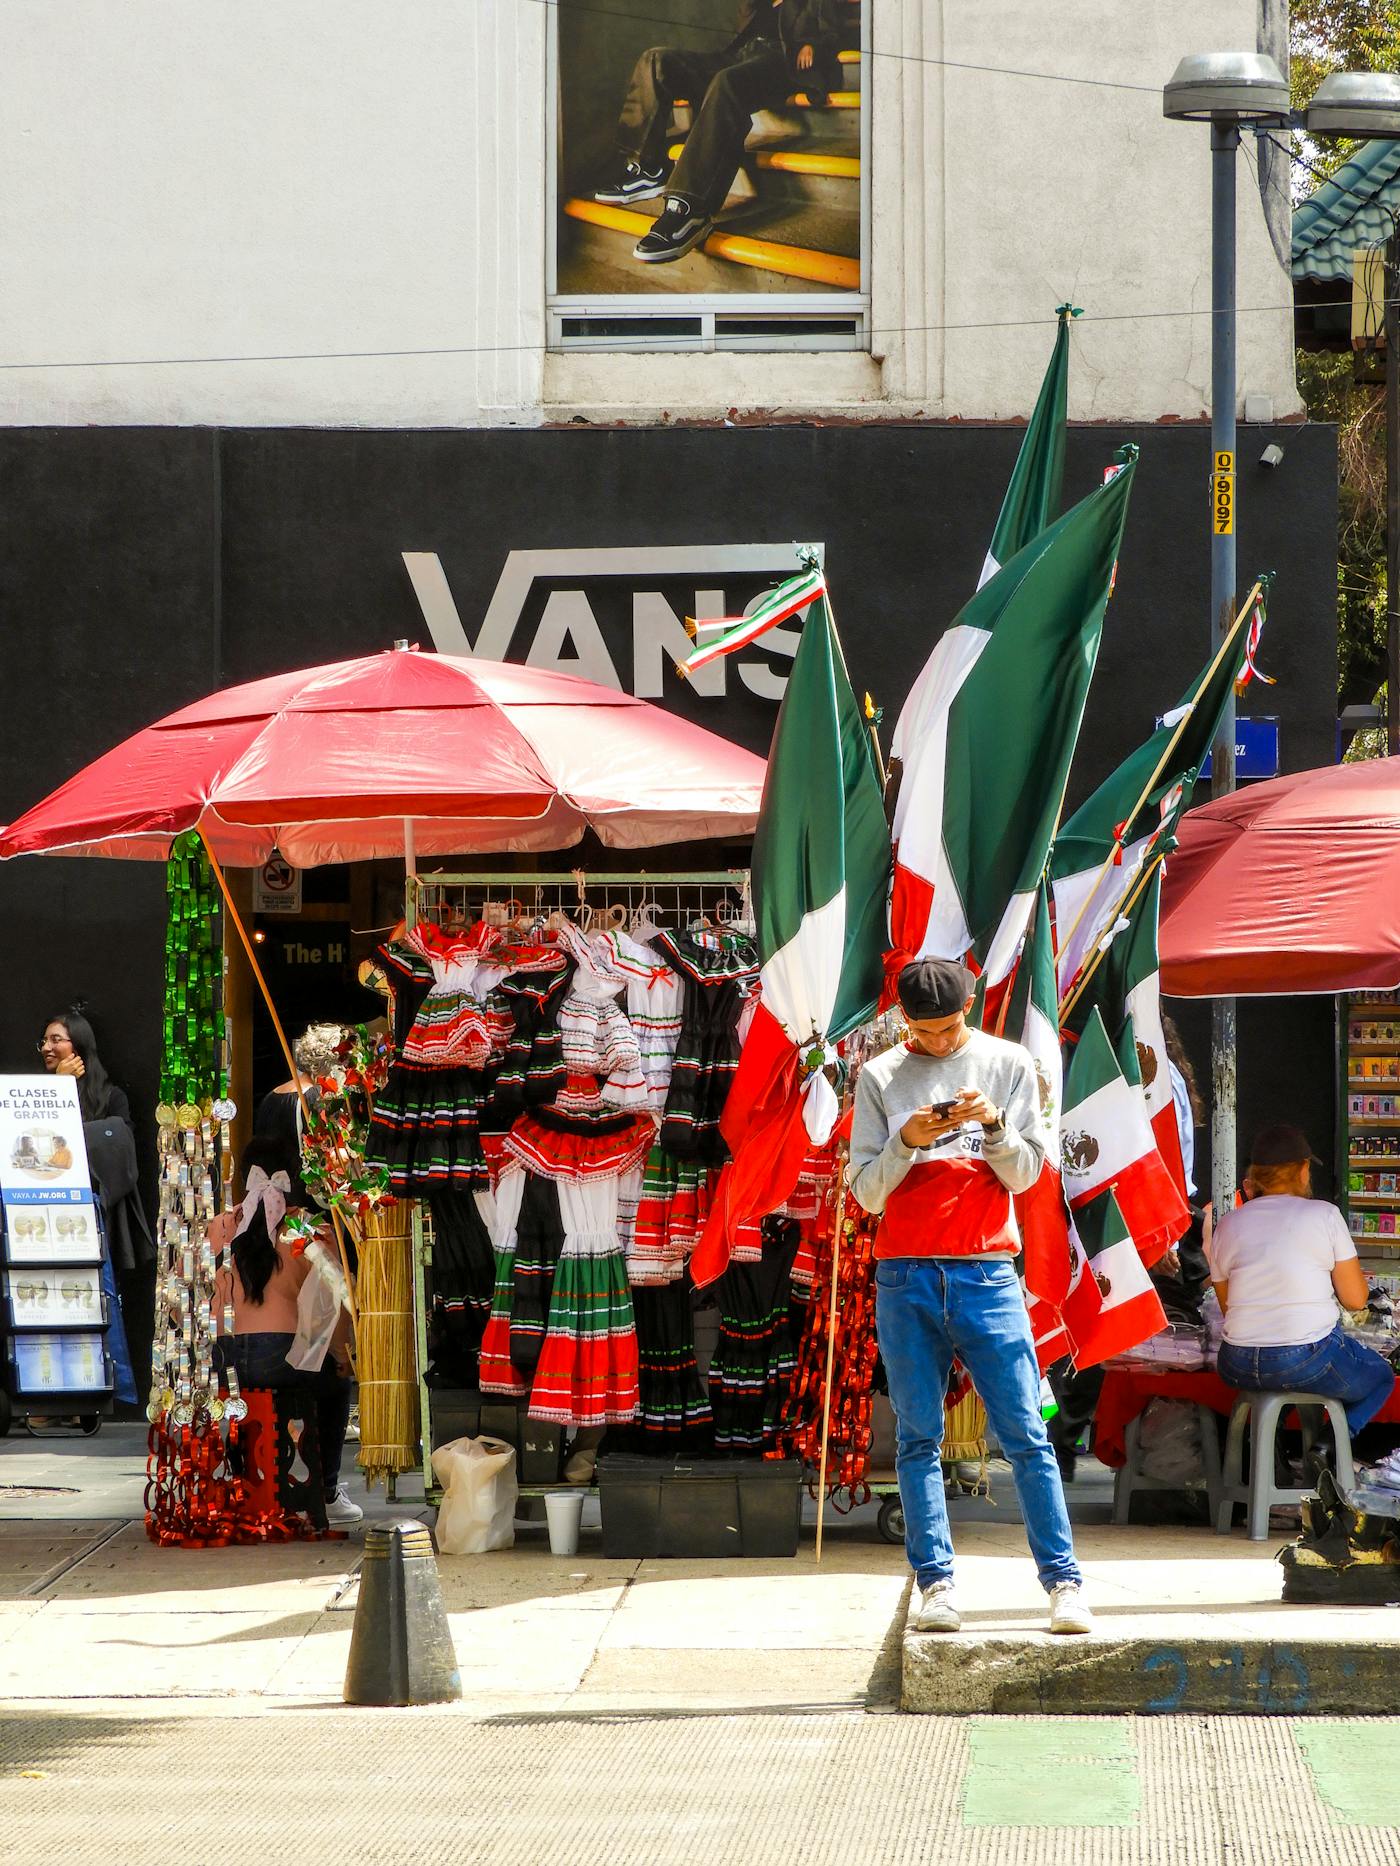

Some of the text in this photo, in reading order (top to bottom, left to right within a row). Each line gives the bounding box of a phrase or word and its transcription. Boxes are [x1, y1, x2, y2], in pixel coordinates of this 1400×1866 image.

[402, 543, 824, 699] VANS
[283, 943, 322, 963] The
[9, 1089, 57, 1098] CLASES
[14, 1100, 30, 1109] LA
[33, 1100, 76, 1109] BIBLIA
[14, 1110, 59, 1120] GRATIS
[962, 1137, 981, 1153] SB
[39, 1191, 67, 1199] JW.ORG
